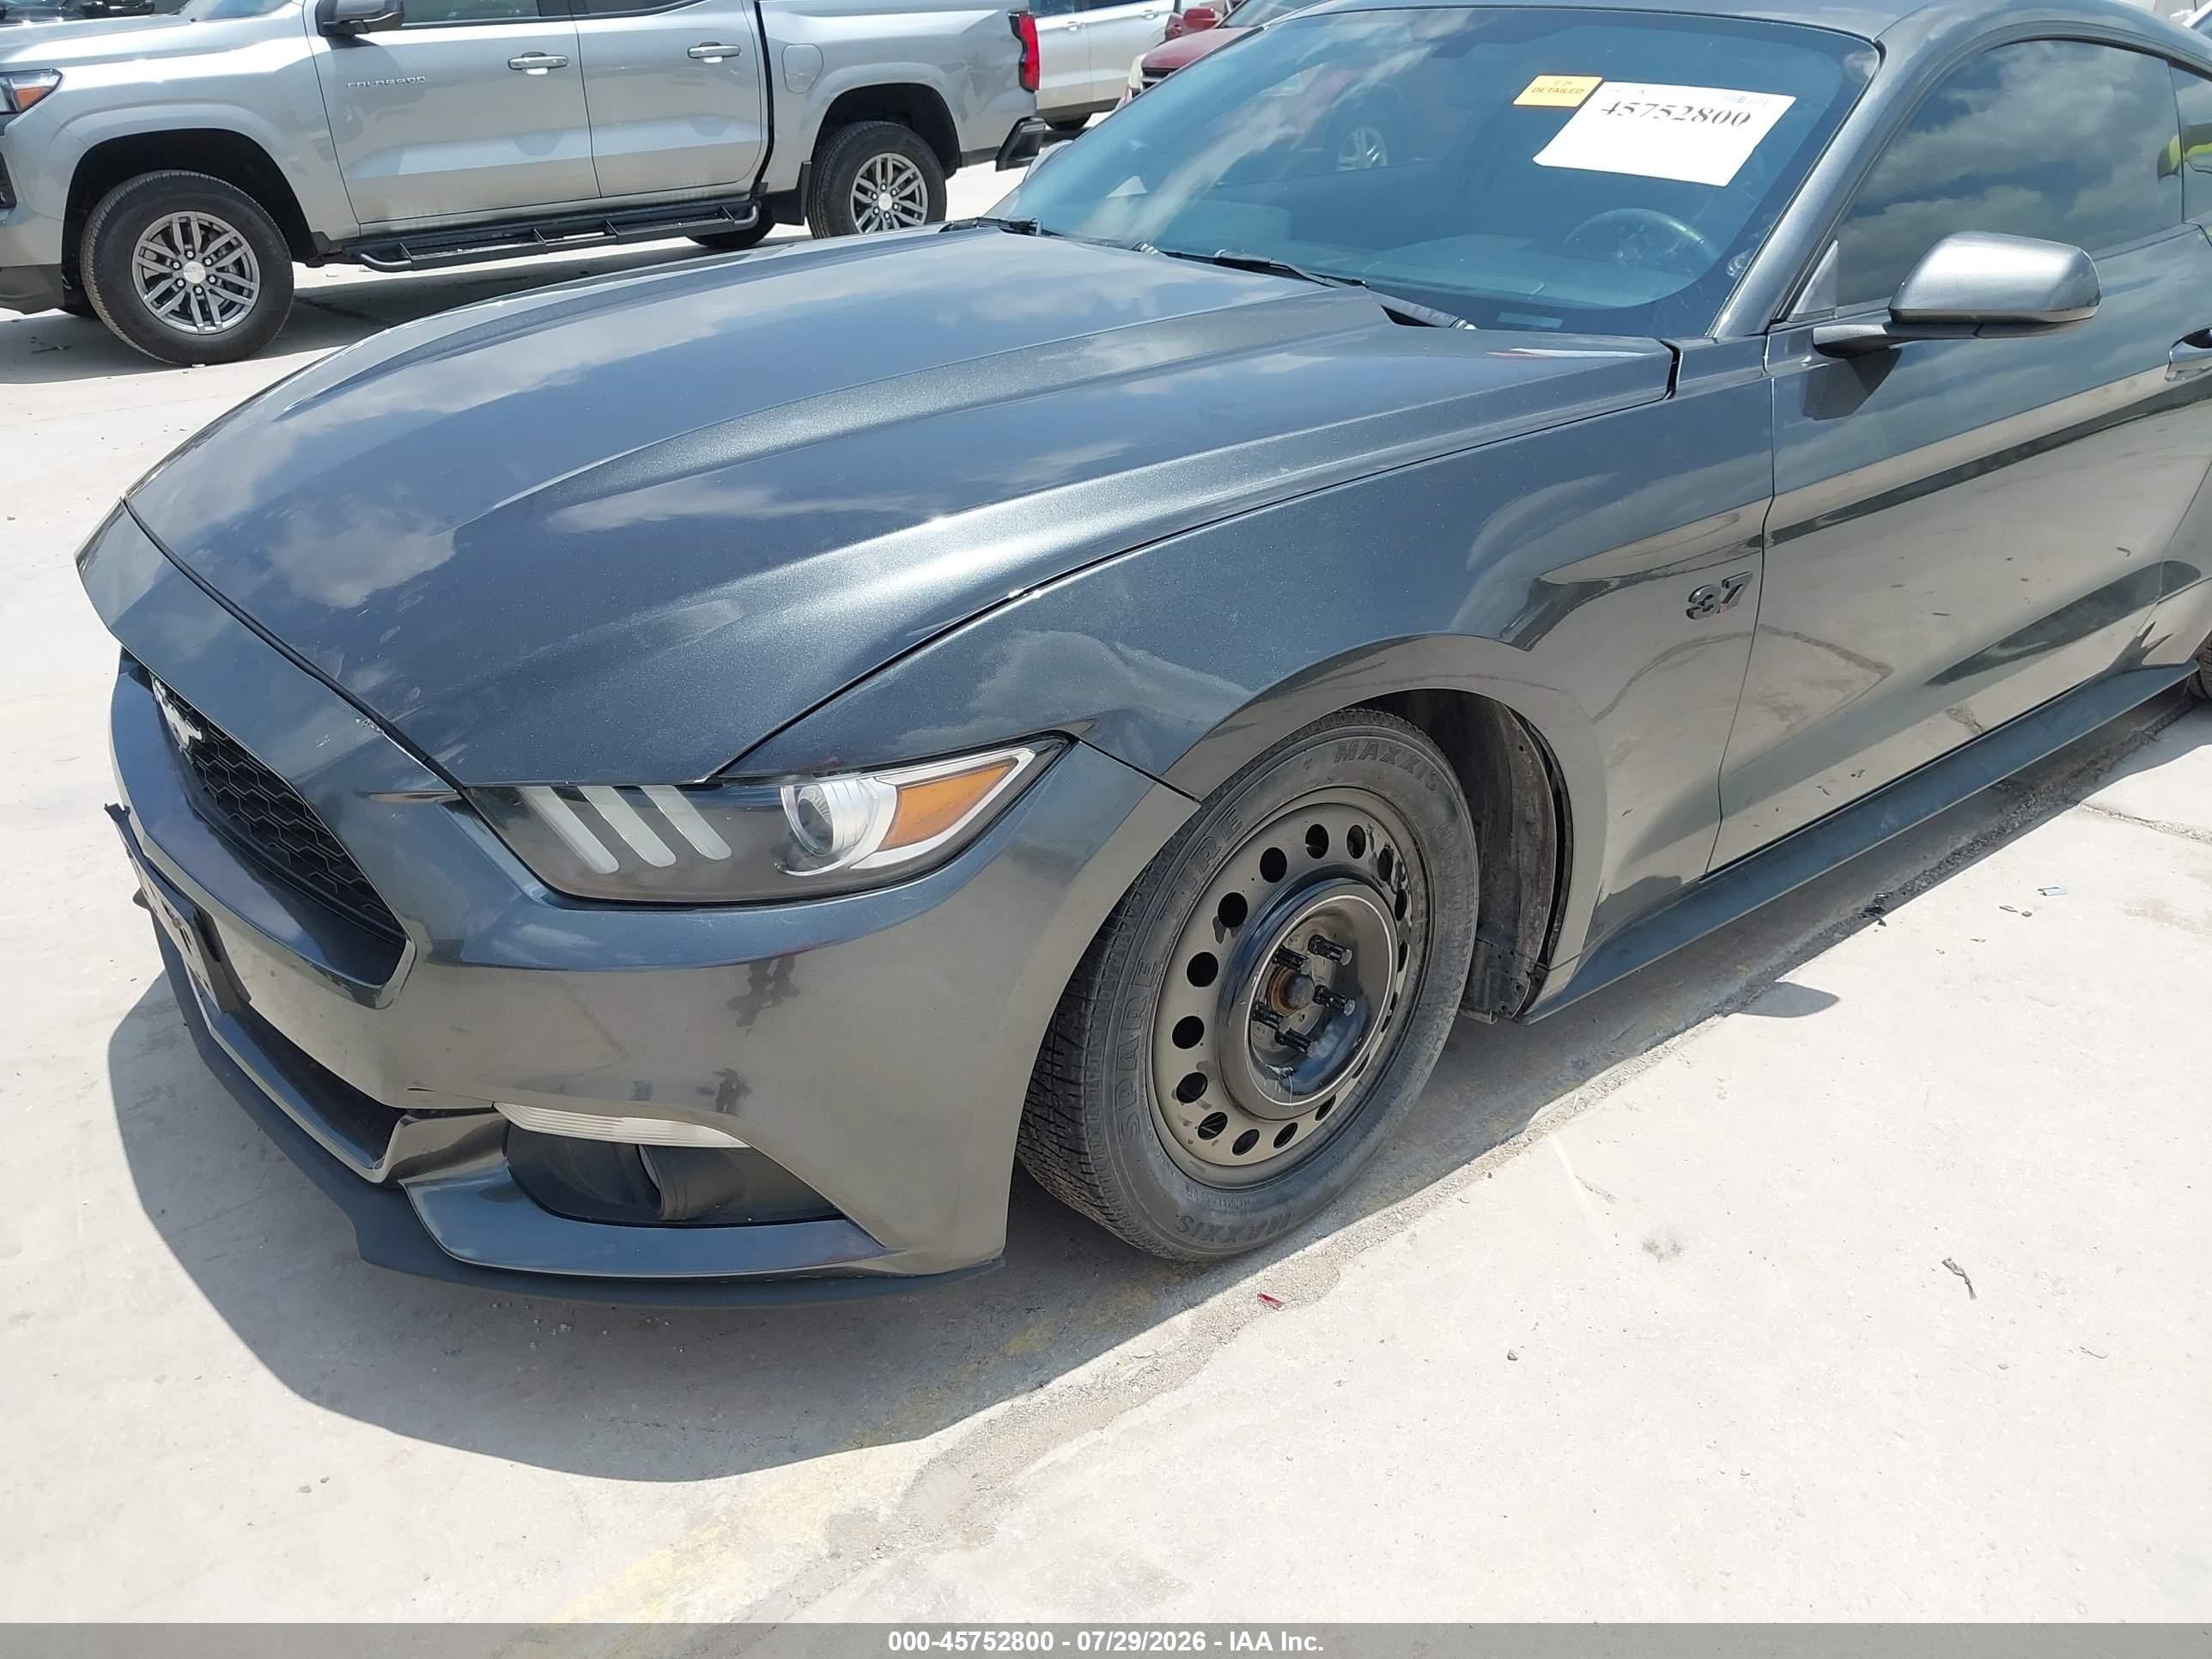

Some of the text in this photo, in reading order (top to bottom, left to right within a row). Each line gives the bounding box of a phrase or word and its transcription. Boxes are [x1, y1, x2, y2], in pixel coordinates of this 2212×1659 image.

[1601, 100, 1752, 127] 45752800
[1333, 741, 1440, 792] MAXXIS
[1116, 960, 1159, 1142] SPARE
